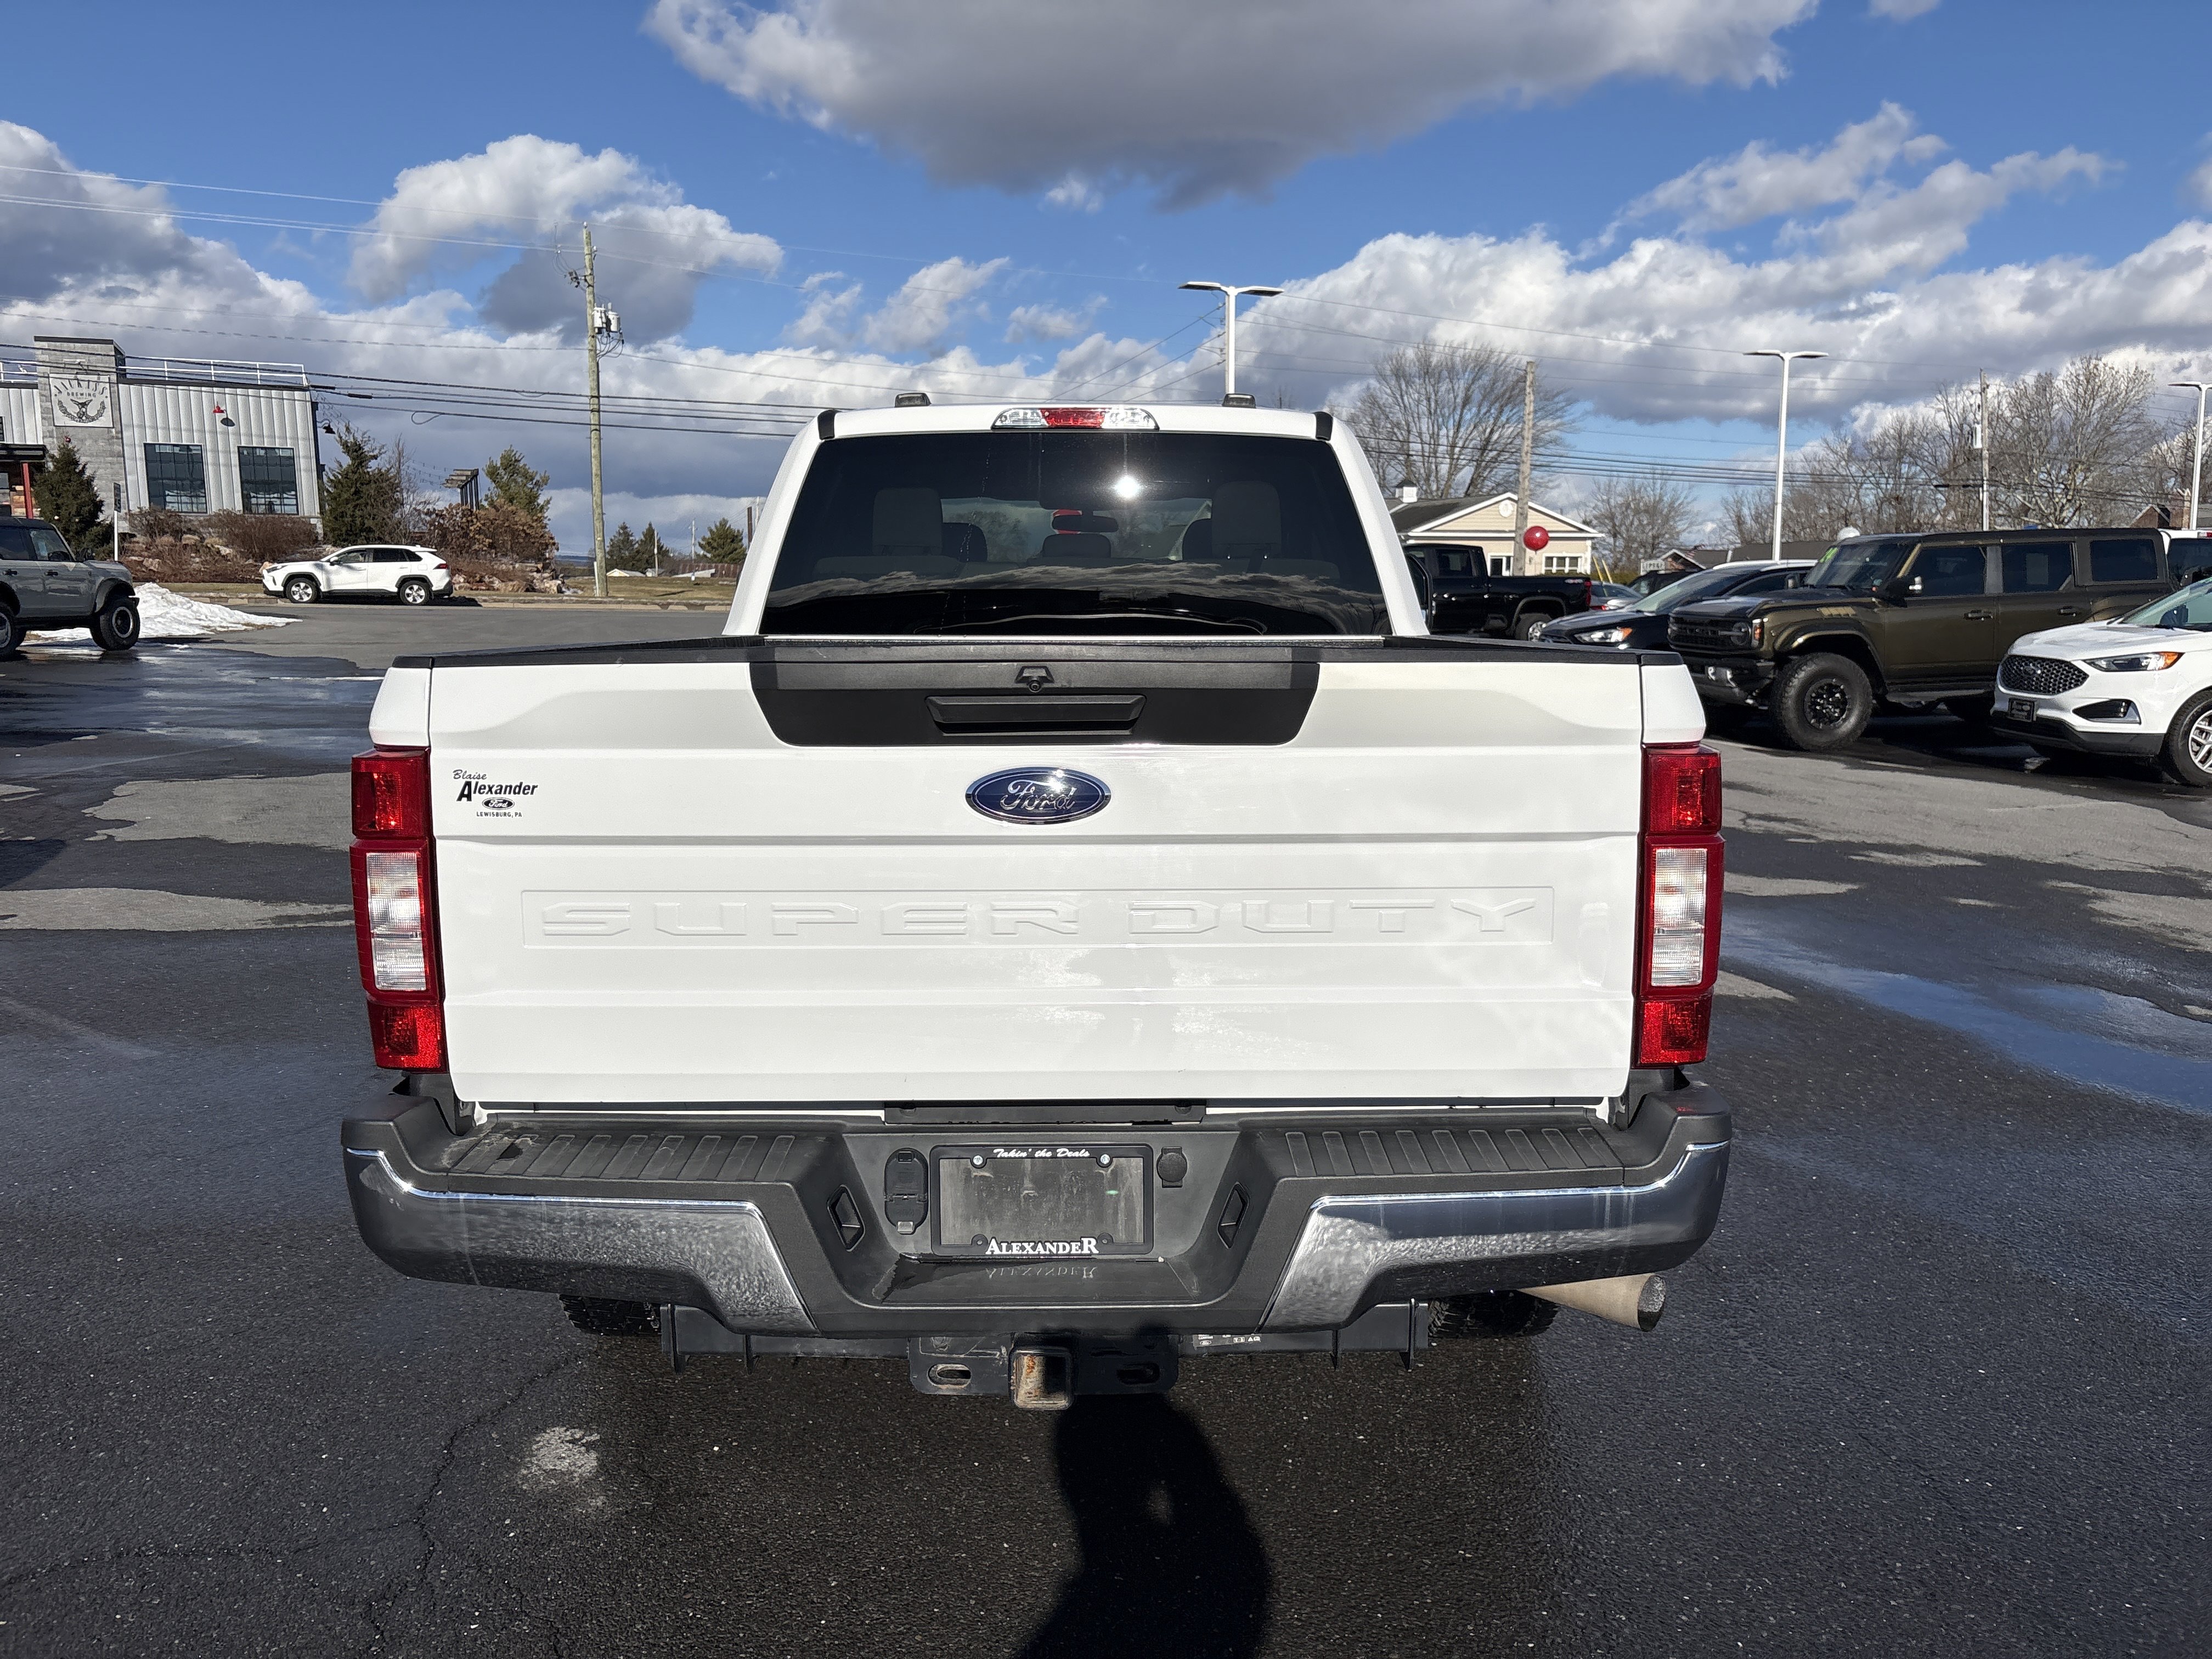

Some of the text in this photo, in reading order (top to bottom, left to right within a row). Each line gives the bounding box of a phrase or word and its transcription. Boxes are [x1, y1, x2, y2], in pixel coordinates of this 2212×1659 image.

[453, 769, 487, 780] Blaise
[456, 781, 538, 802] Alexander
[542, 899, 1537, 936] SUPER DUTY
[993, 1148, 1090, 1158] Takin' the Deals
[985, 1238, 1099, 1255] ALEXANDER
